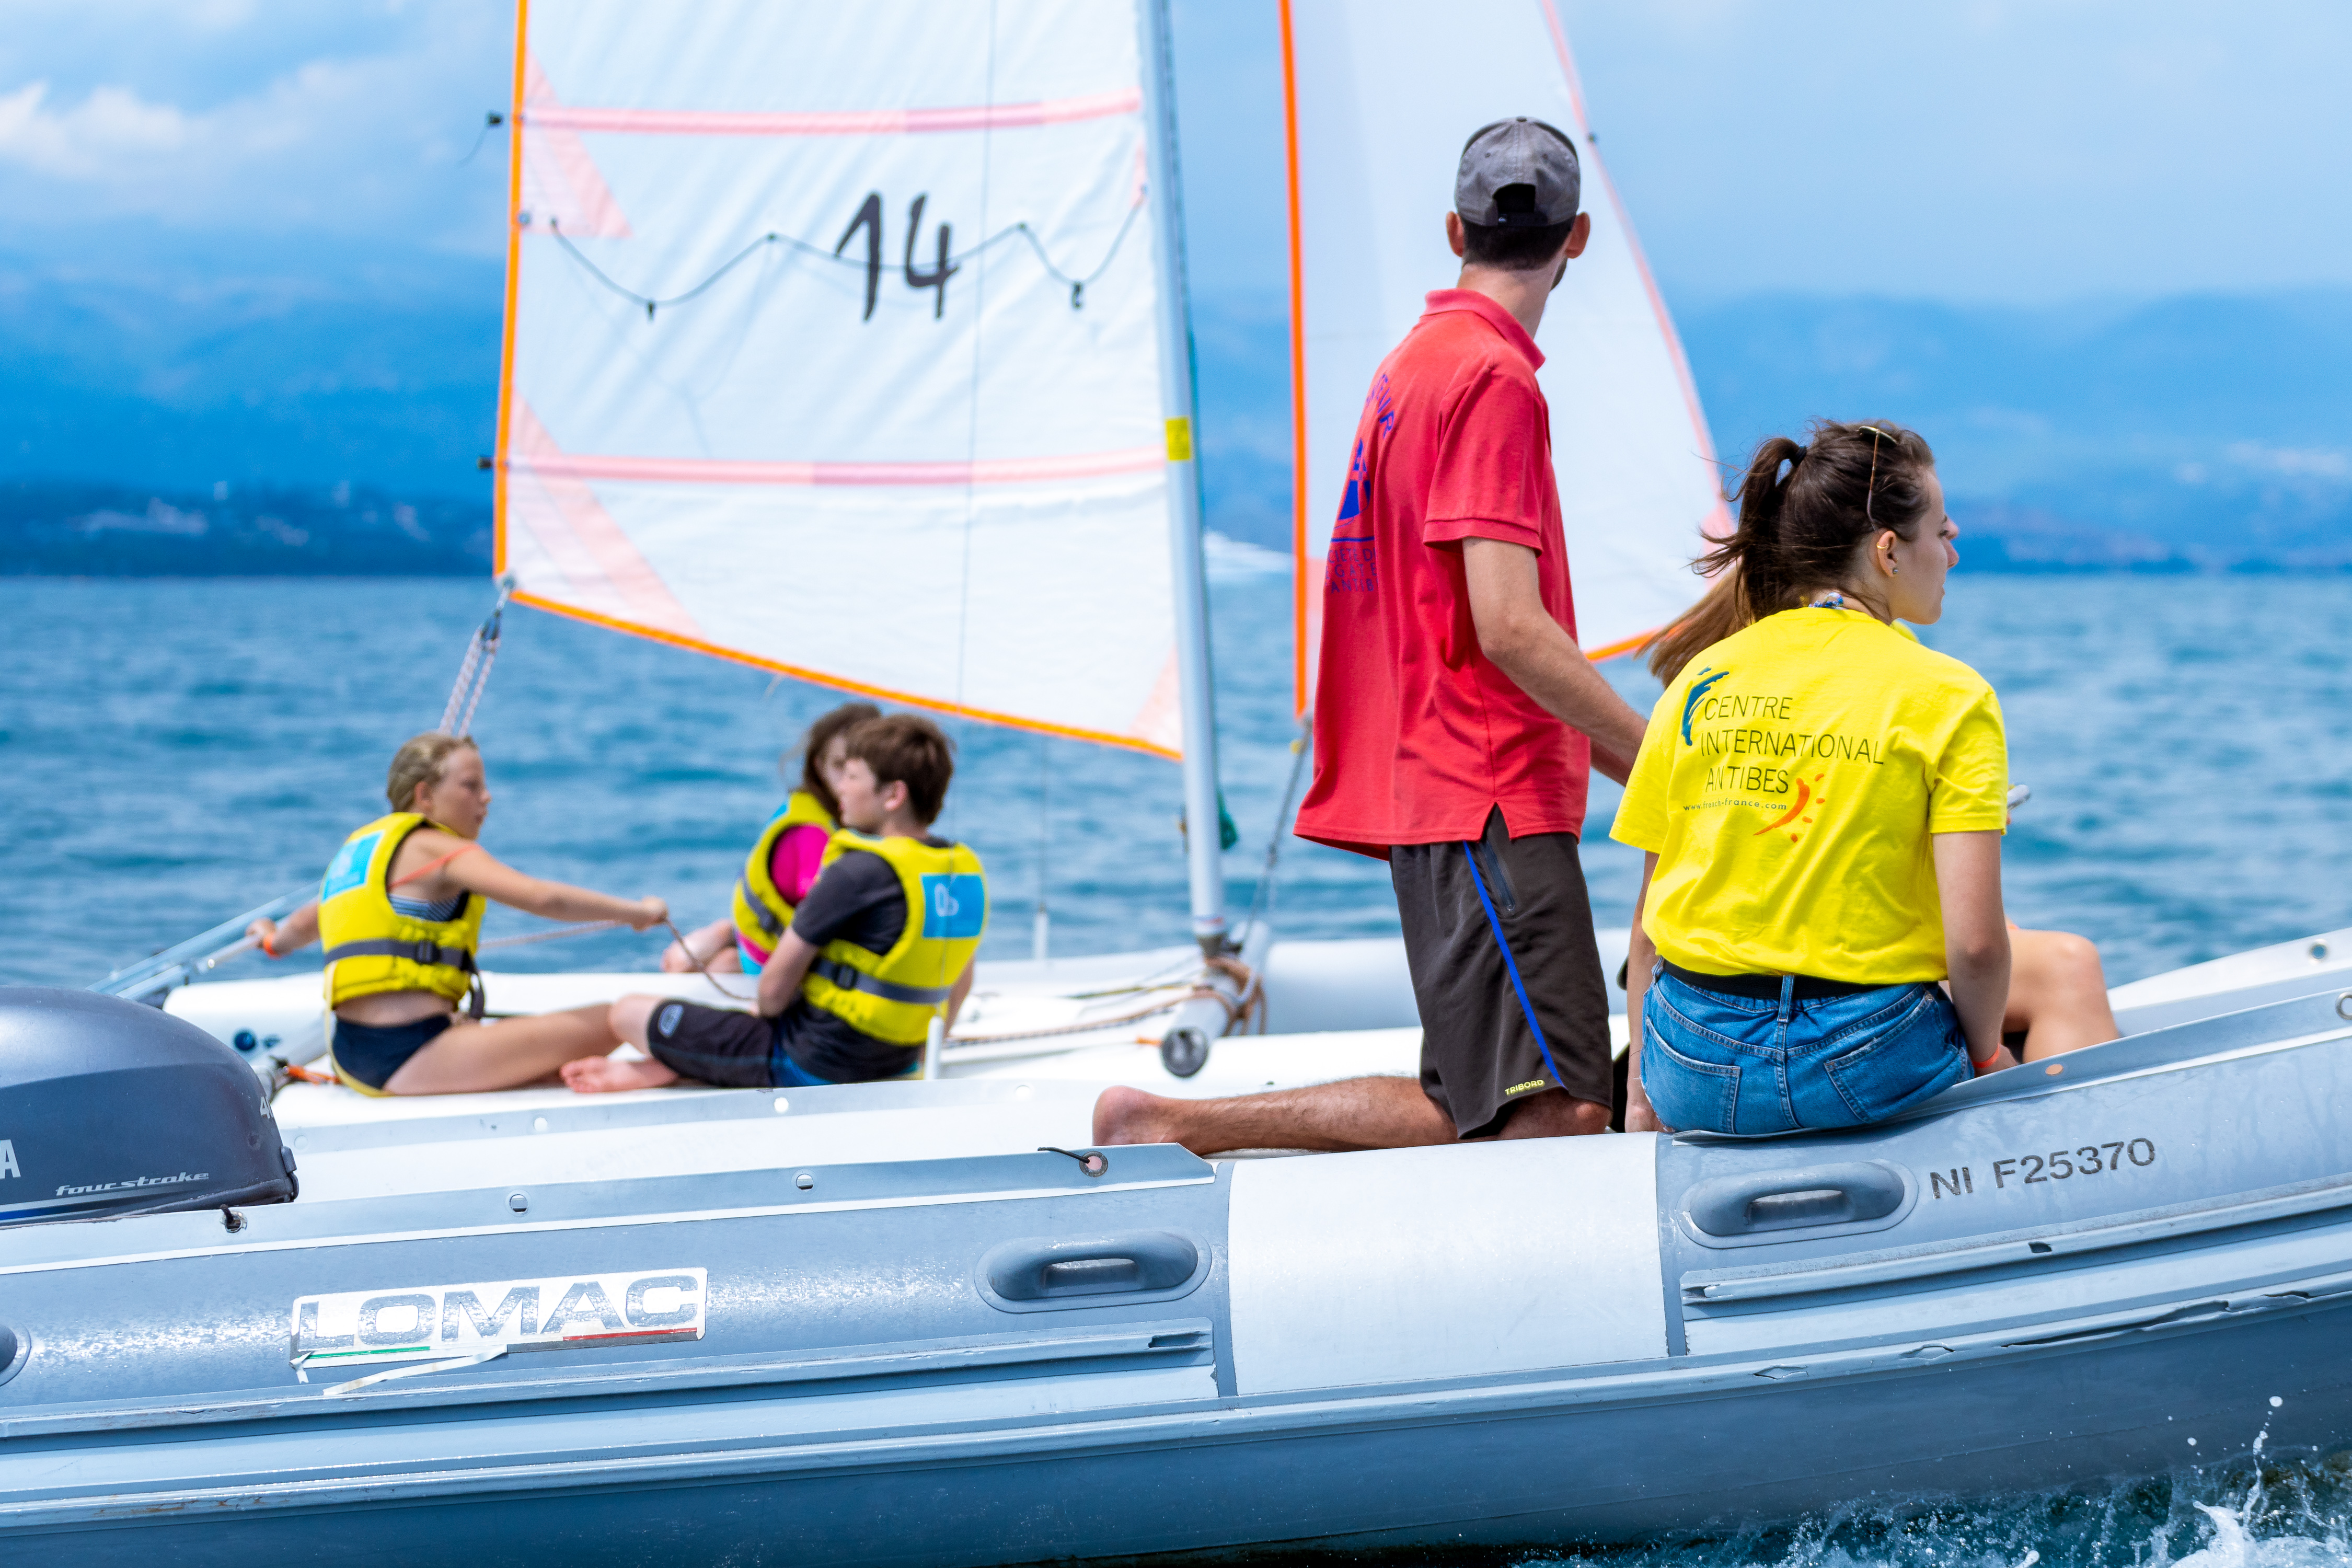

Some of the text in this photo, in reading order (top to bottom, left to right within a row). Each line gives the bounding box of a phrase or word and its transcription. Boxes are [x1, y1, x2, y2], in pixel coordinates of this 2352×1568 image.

[836, 192, 960, 321] 14
[1704, 695, 1793, 721] CENTRE
[1701, 729, 1884, 765] INTERNATIONAL
[1705, 765, 1789, 793] ANTIBES
[1683, 798, 1787, 811] www.french-france.com
[1505, 1079, 1544, 1096] TRIBORD
[260, 1096, 274, 1119] 4
[1930, 1137, 2155, 1199] NI F25370
[298, 1275, 698, 1352] LOMAC
